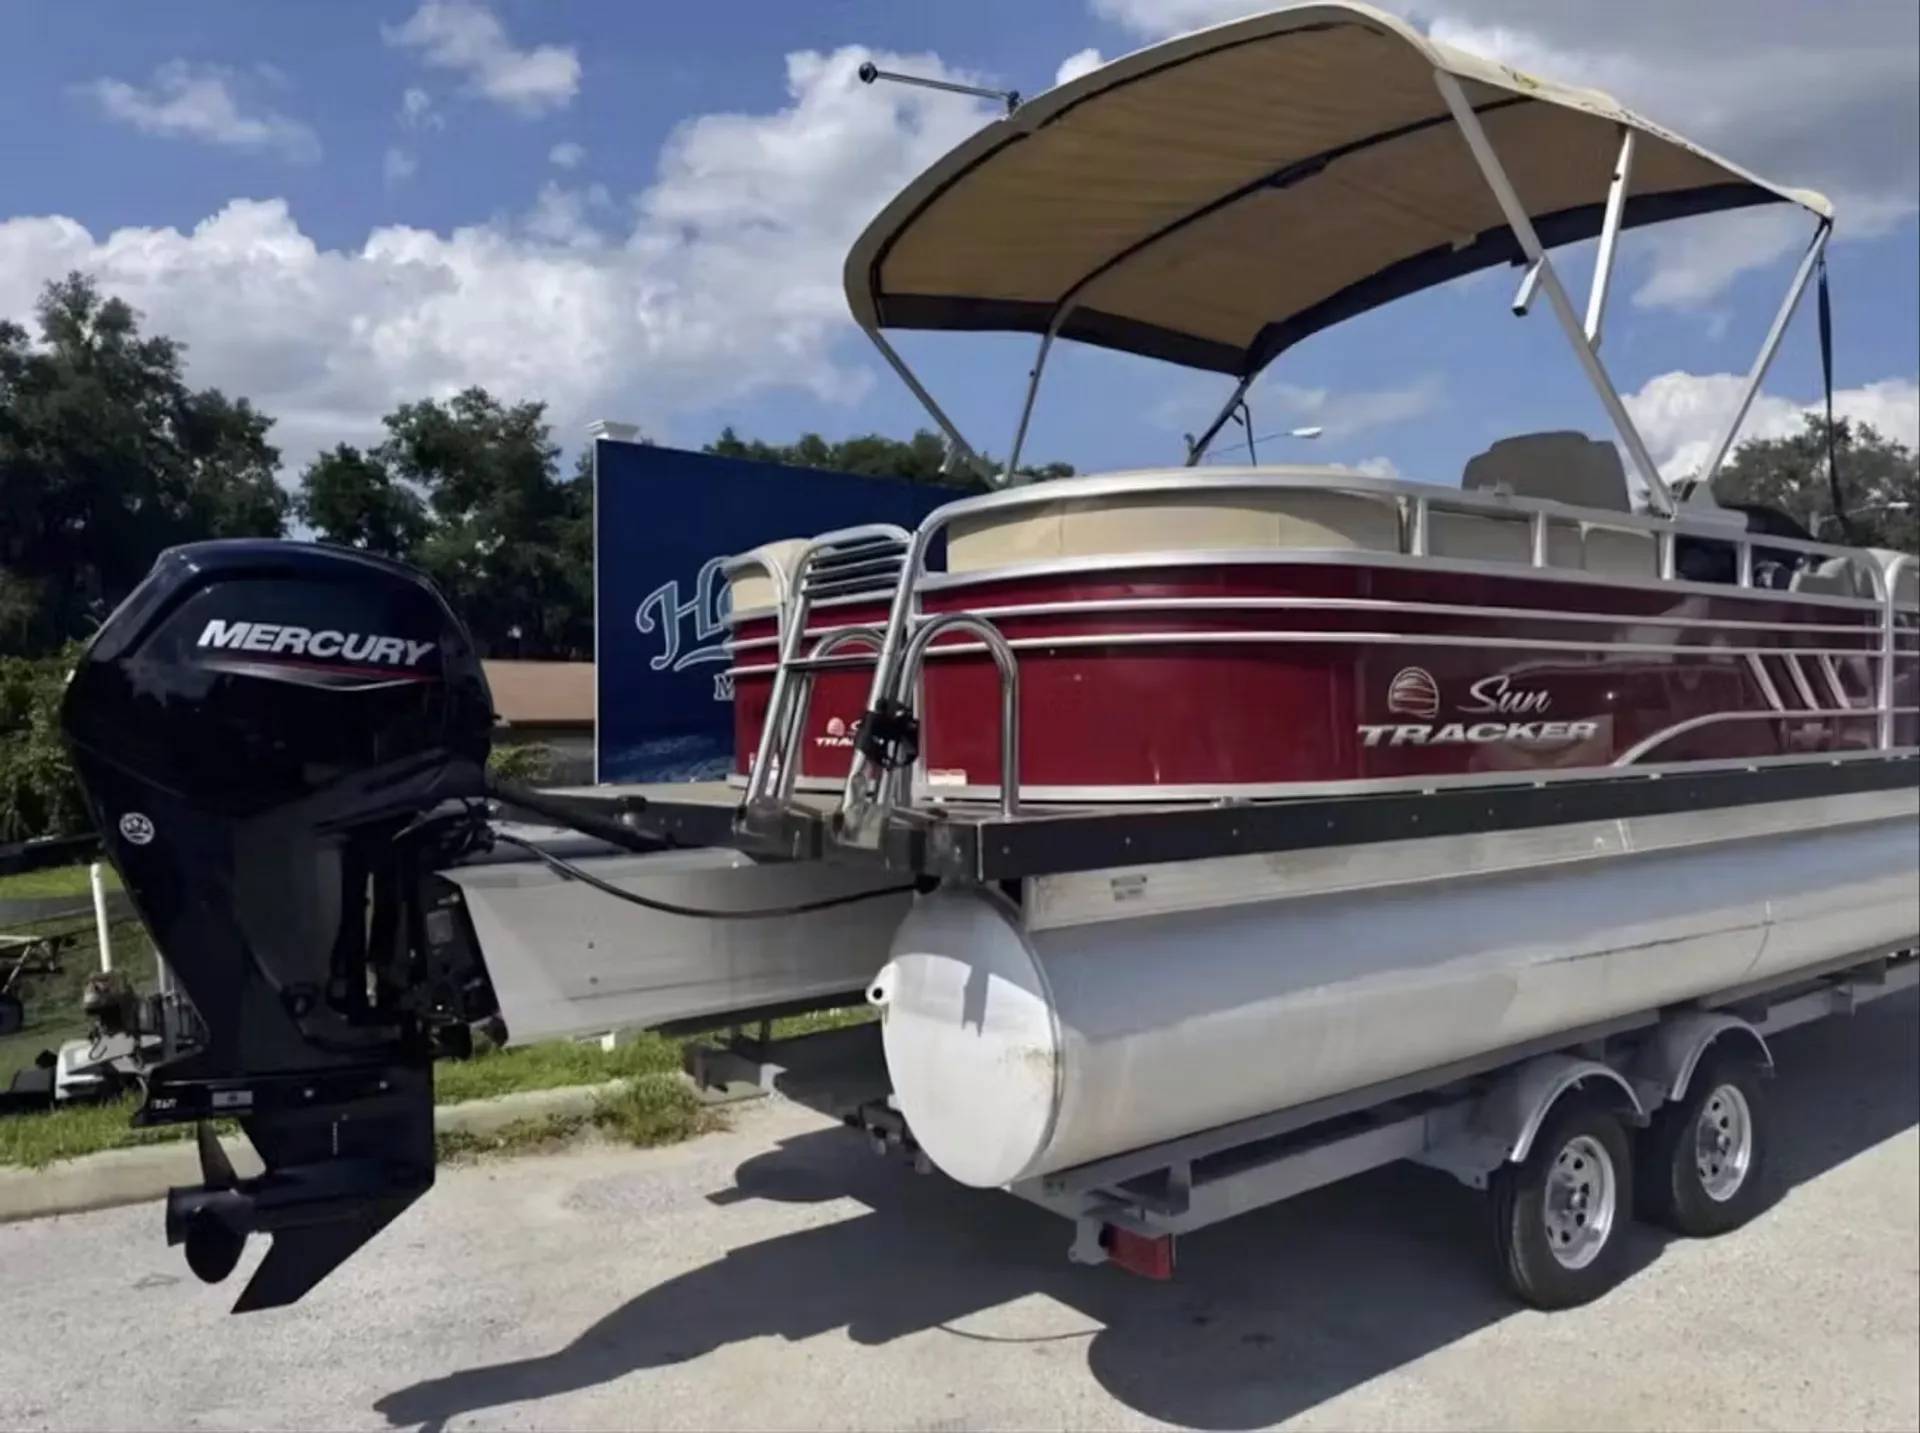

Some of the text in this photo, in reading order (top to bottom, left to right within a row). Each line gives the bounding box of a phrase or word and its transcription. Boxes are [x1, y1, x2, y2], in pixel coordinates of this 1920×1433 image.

[197, 619, 435, 665] MERCURY
[1456, 675, 1551, 713] Sun
[1357, 722, 1598, 746] TRACKER
